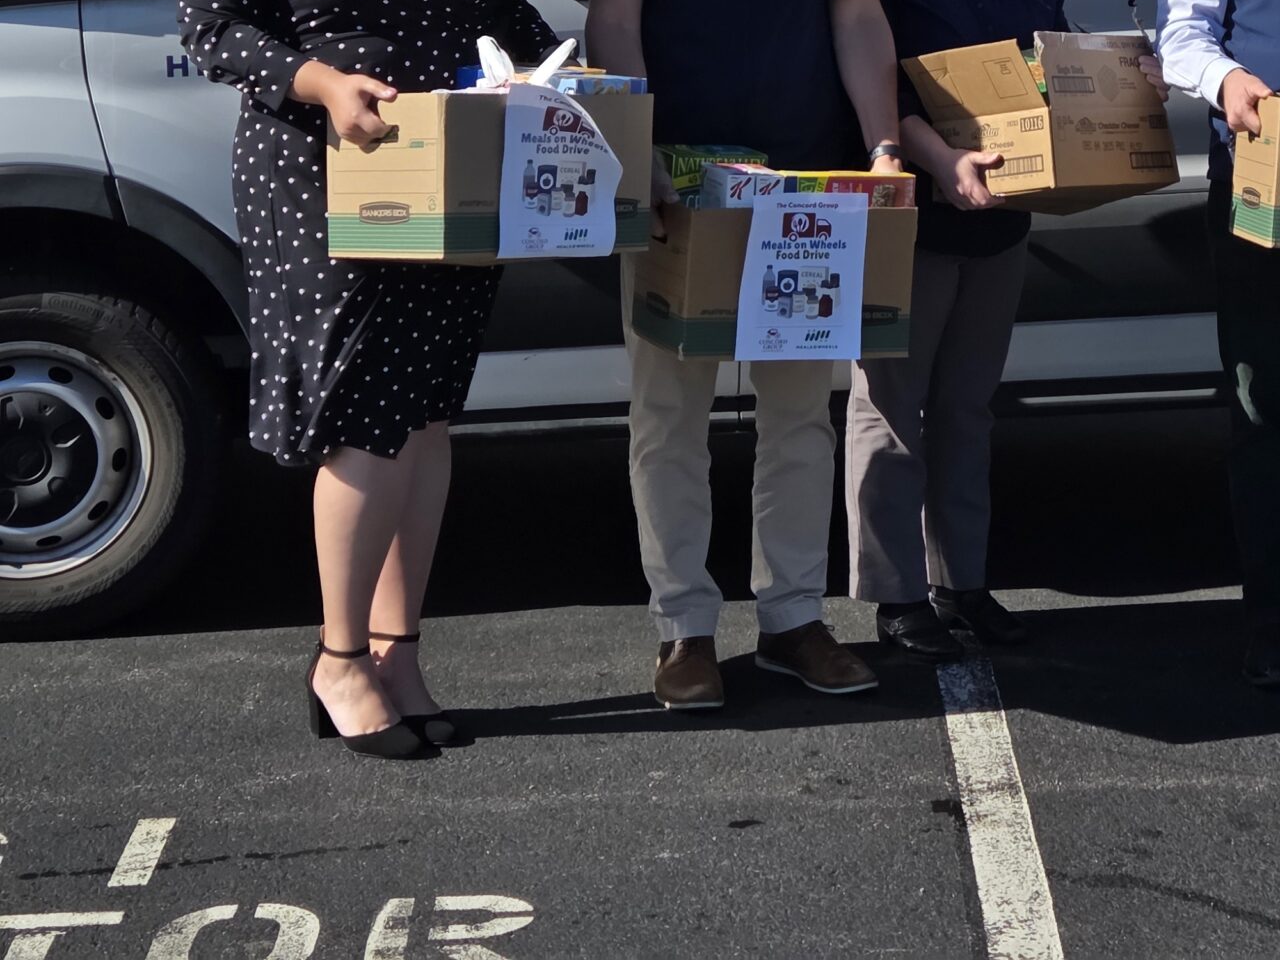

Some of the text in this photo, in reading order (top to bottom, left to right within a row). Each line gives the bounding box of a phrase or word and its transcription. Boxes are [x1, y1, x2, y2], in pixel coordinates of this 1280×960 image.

[521, 133, 551, 143] Meals
[554, 135, 566, 143] on
[536, 144, 590, 155] Food Drive
[761, 240, 791, 250] Meals
[810, 240, 846, 249] Wheels
[776, 250, 830, 260] Food Drive
